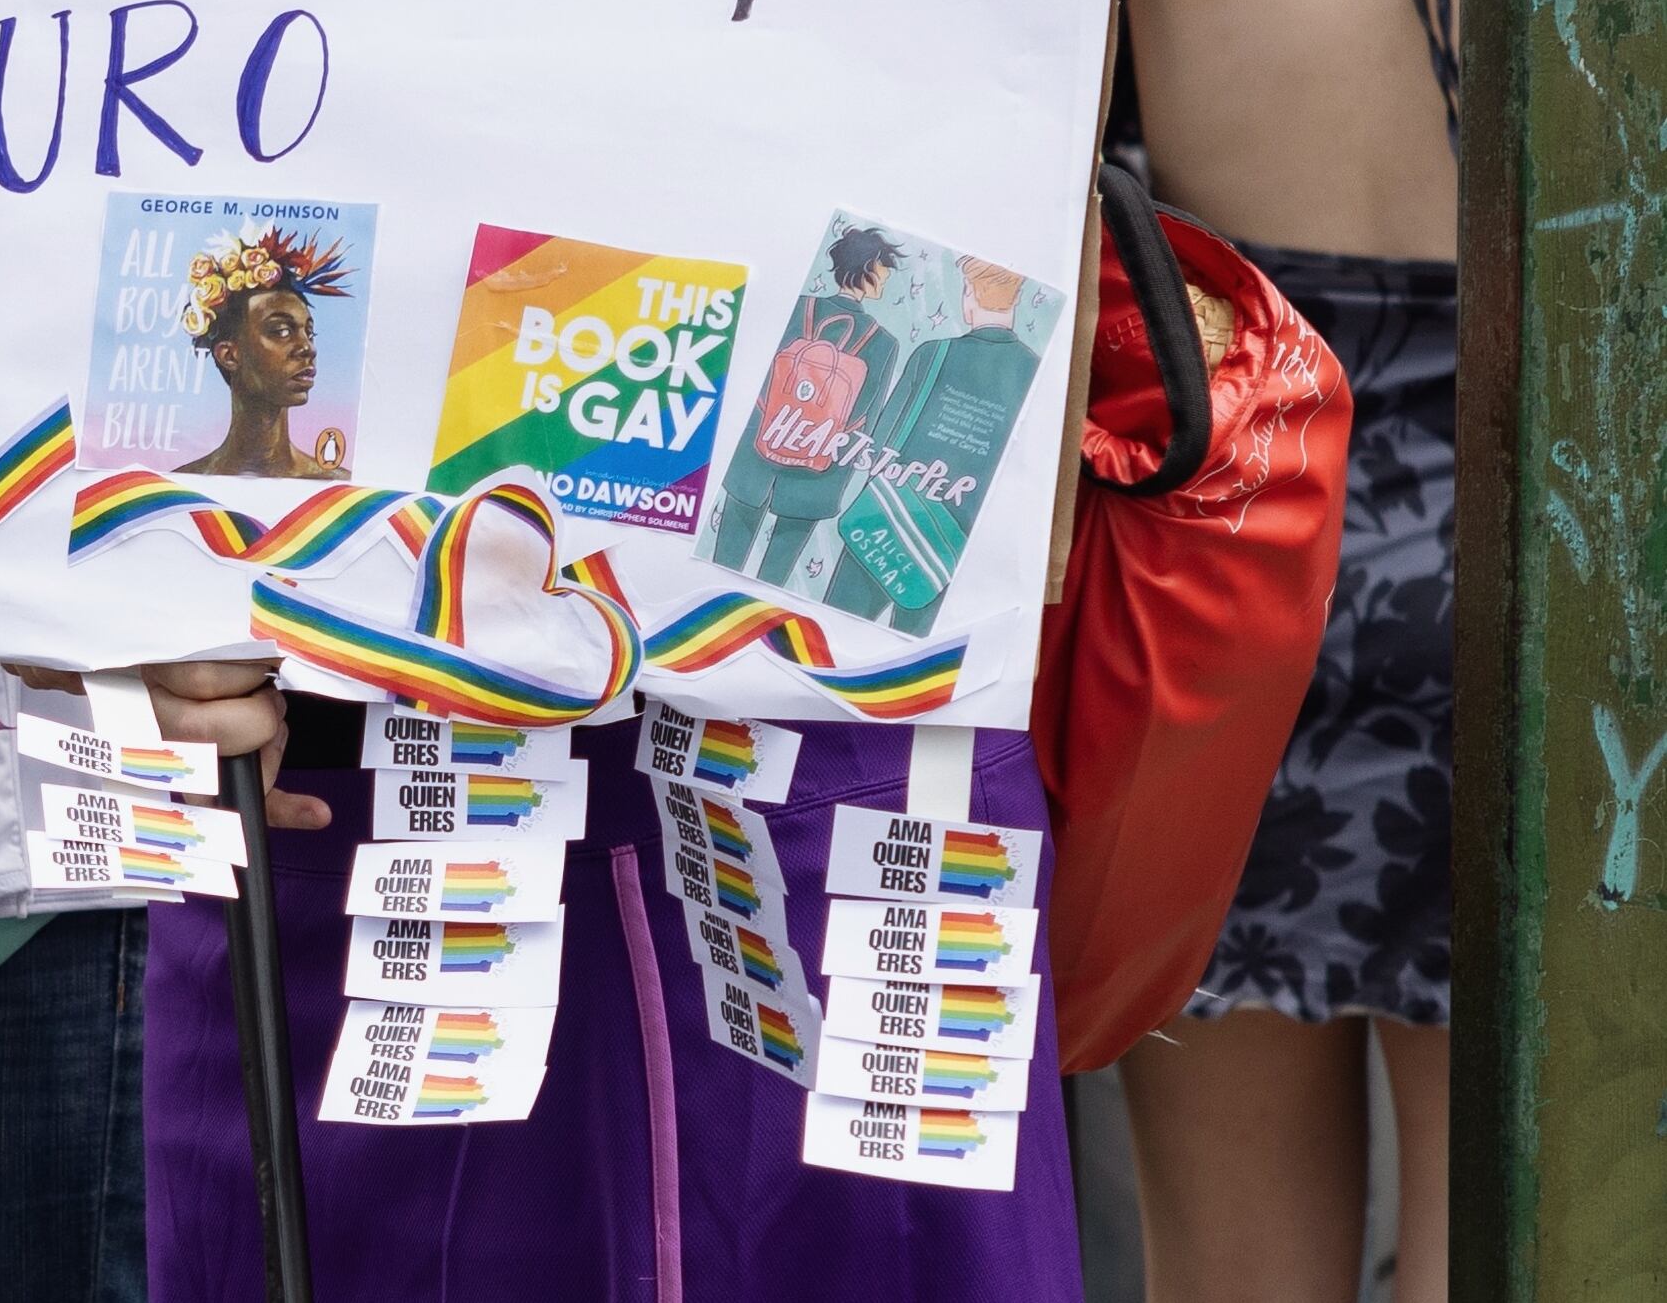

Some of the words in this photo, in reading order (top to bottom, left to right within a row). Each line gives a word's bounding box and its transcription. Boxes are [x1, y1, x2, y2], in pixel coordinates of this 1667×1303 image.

[141, 199, 213, 214] GEORGE
[223, 202, 244, 216] M.
[252, 203, 339, 220] JOHNSON
[121, 228, 174, 278] ALL
[637, 277, 735, 330] THIS
[513, 305, 728, 393] BOOK
[520, 371, 562, 414] IS
[567, 381, 716, 452] GAY
[102, 402, 182, 452] BLUE
[762, 404, 977, 506] HEARTSTOPPER
[577, 477, 696, 517] DAWSON
[575, 505, 587, 514] BY
[588, 507, 646, 523] CHRISTOPHER
[850, 529, 906, 595] OSEMAN
[872, 528, 911, 574] ALICE
[70, 732, 112, 751] AMA
[384, 717, 440, 742] QUIEN
[650, 720, 693, 753] QUIEN
[58, 740, 112, 762] QUIEN
[393, 743, 439, 766] ERES
[651, 747, 686, 776] ERES
[69, 754, 112, 774] ERES
[77, 793, 120, 812] AMA
[399, 785, 456, 809] QUIEN
[66, 807, 122, 827] QUIEN
[409, 810, 455, 833] ERES
[665, 795, 703, 829] QUIEN
[79, 824, 123, 843] ERES
[677, 820, 707, 850] ERES
[887, 818, 932, 845] AMA
[52, 852, 109, 866] QUIEN
[389, 859, 433, 875] AMA
[872, 841, 931, 869] QUIEN
[65, 867, 110, 882] ERES
[675, 851, 710, 886] QUIEN
[880, 867, 927, 894] ERES
[374, 876, 431, 894] QUIEN
[683, 878, 712, 908] ERES
[382, 896, 428, 913] ERES
[386, 920, 431, 940] AMA
[883, 907, 927, 929] AMA
[699, 920, 735, 953] QUIEN
[868, 928, 926, 952] QUIEN
[373, 940, 431, 960] QUIEN
[709, 945, 739, 975] ERES
[381, 962, 427, 981] ERES
[876, 952, 922, 975] ERES
[725, 982, 752, 1013] AMA
[871, 991, 929, 1016] QUIEN
[381, 1006, 425, 1025] AMA
[720, 1001, 755, 1035] QUIEN
[879, 1015, 926, 1039] ERES
[365, 1024, 422, 1043] QUIEN
[729, 1025, 758, 1056] ERES
[366, 1060, 412, 1084] AMA
[862, 1052, 918, 1075] QUIEN
[349, 1077, 408, 1102] QUIEN
[871, 1074, 916, 1096] ERES
[354, 1098, 402, 1121] ERES
[863, 1101, 907, 1121] AMA
[849, 1119, 906, 1141] QUIEN
[859, 1141, 904, 1161] ERES
